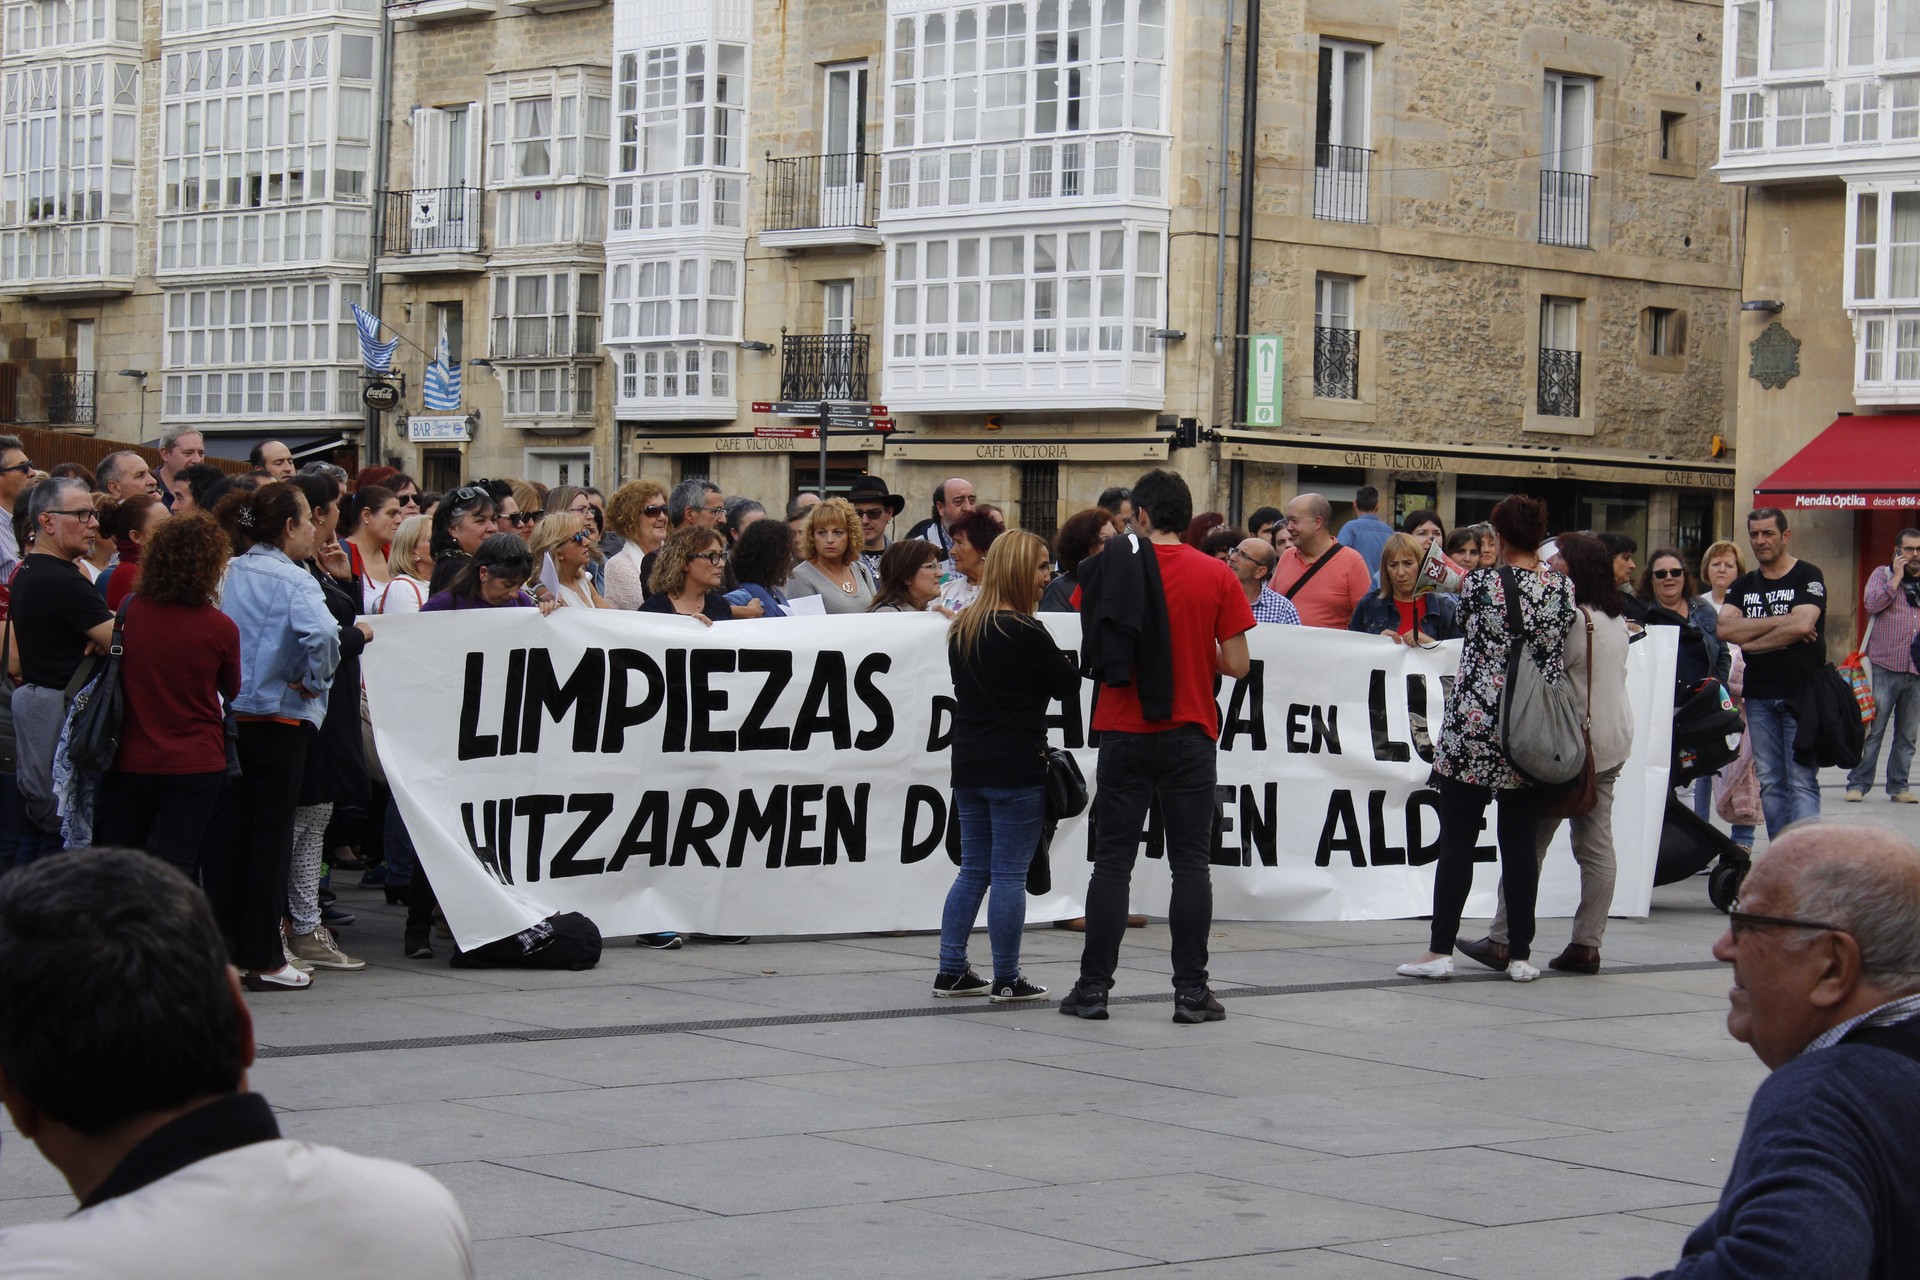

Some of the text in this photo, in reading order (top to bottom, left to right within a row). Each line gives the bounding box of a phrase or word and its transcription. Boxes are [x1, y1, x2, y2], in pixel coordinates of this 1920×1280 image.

[413, 422, 431, 437] BAR
[716, 437, 795, 451] CAFE VICTORIA
[976, 445, 1068, 458] CAFE VICTORIA
[1344, 451, 1443, 470] CAFE VICTORIA
[1665, 470, 1693, 485] CAFE
[1795, 494, 1831, 506] Mendia
[1832, 495, 1866, 508] Optika
[1873, 496, 1895, 506] desde
[1896, 496, 1916, 506] 1856
[1743, 588, 1795, 607] PHILDELPHIA
[458, 647, 895, 761] LIMPIEZAS
[926, 695, 958, 752] D
[1286, 703, 1342, 755] EN
[460, 783, 871, 886] HITZARMEN
